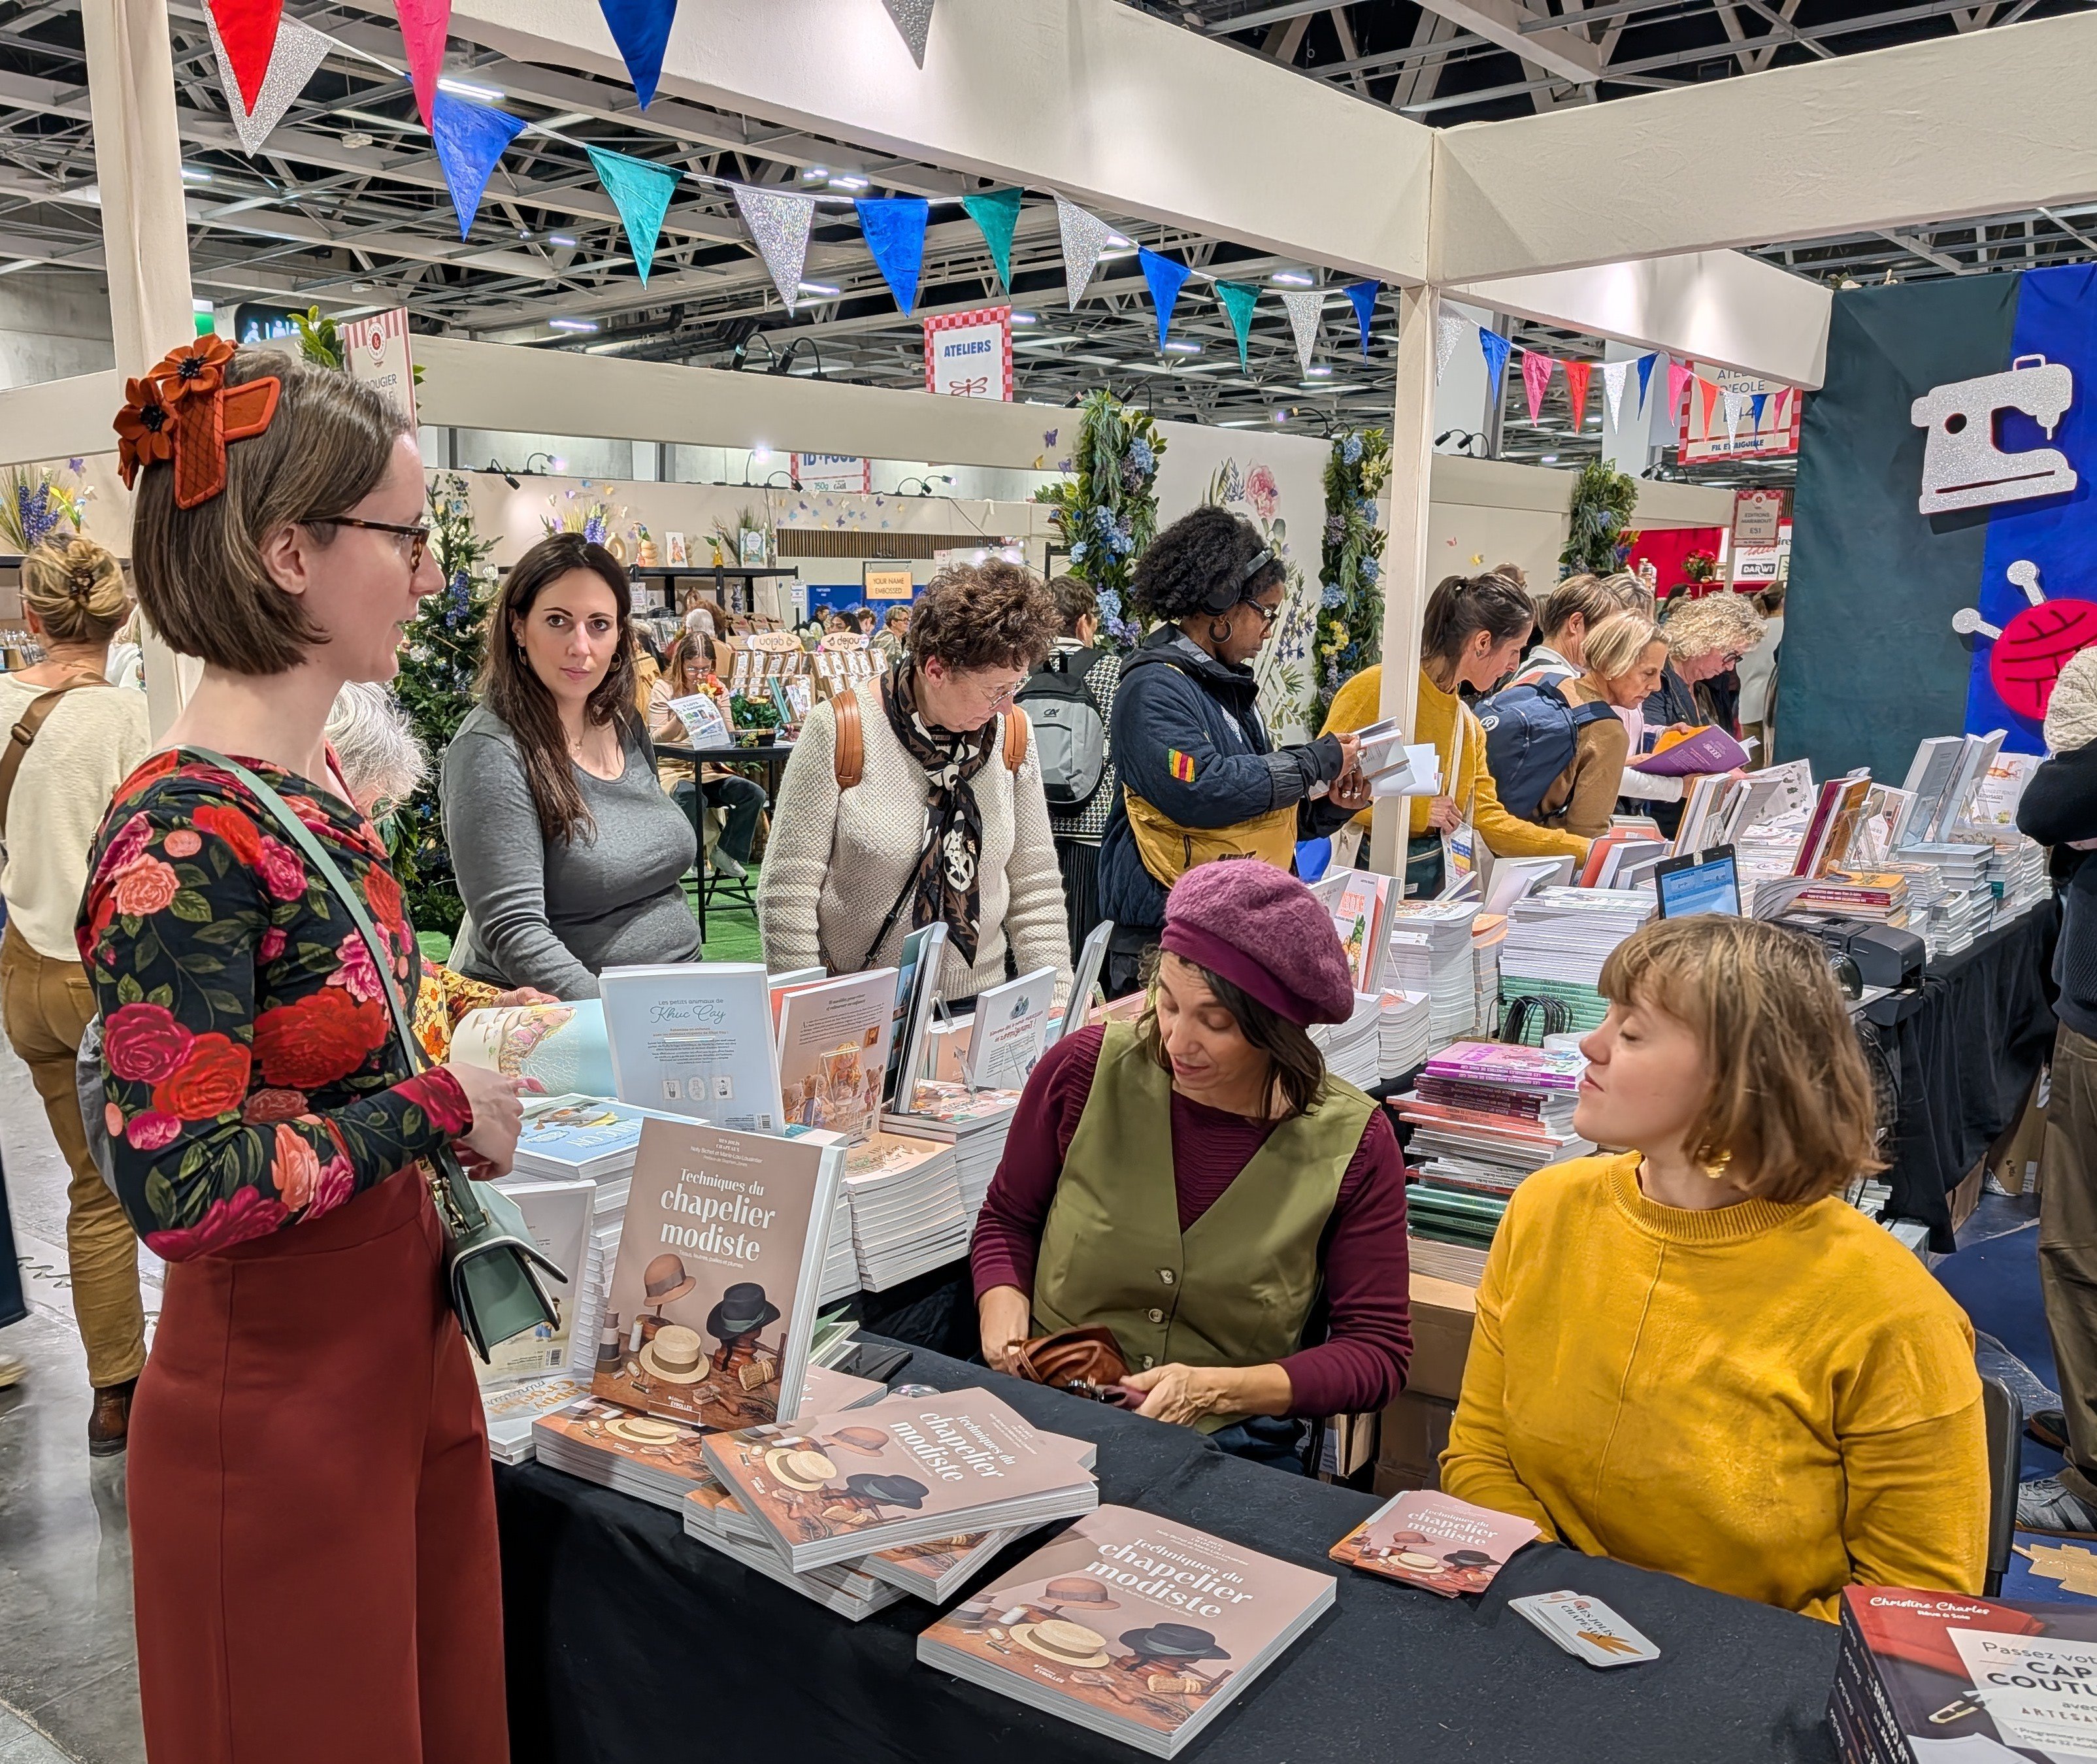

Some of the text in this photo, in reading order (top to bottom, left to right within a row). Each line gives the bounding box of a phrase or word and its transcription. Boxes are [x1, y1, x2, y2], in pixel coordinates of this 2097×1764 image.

[944, 340, 991, 358] ATELIERS
[650, 1006, 690, 1023] Khuc
[680, 1168, 765, 1196] Techniques du
[661, 1183, 776, 1229] chapelier
[660, 1223, 760, 1261] modiste
[727, 1259, 744, 1269] plumes
[889, 1422, 964, 1482] modiste
[919, 1413, 1004, 1477] chapelier
[957, 1414, 1003, 1455] Techniques
[999, 1454, 1016, 1465] du
[1408, 1512, 1498, 1537] chapelier
[1425, 1508, 1474, 1524] Techniques
[1407, 1522, 1486, 1545] modiste
[1098, 1544, 1253, 1603] chapelier
[1133, 1538, 1244, 1584] Techniques du
[1084, 1561, 1221, 1618] modiste
[1870, 1597, 1990, 1616] Christine Charles
[1560, 1605, 1602, 1640] CHAPEAUX
[1981, 1641, 2055, 1659] Passez
[1034, 1668, 1065, 1683] EYROLLES
[2025, 1661, 2092, 1678] CAP
